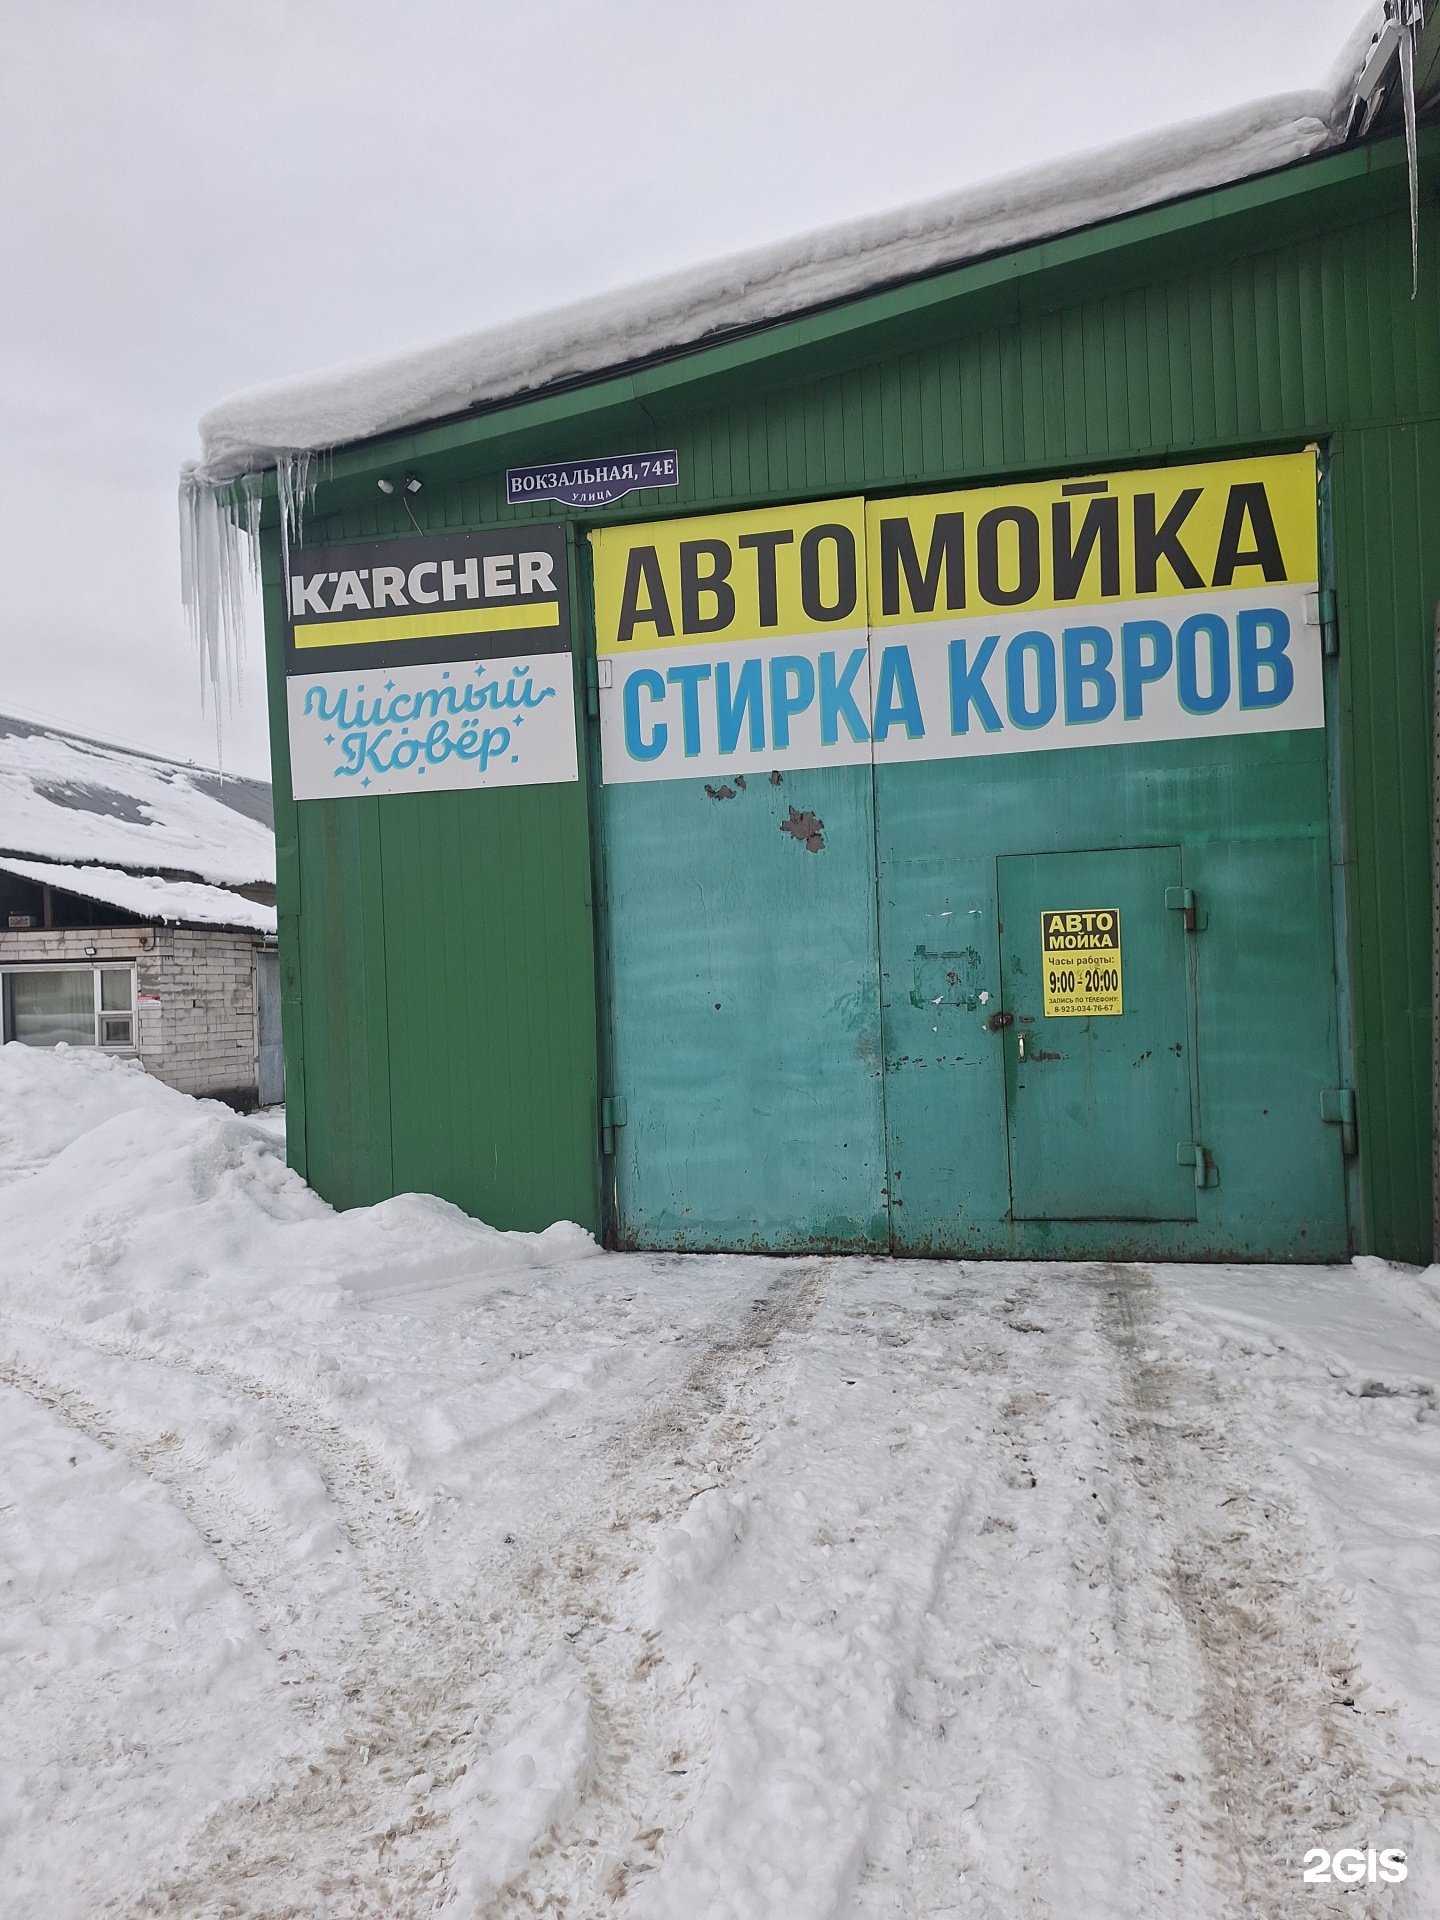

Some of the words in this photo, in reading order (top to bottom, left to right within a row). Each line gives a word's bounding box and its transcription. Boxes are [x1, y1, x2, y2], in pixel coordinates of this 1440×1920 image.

[511, 463, 638, 493] ВОКЗАЛЬНАЯ,
[641, 459, 674, 478] 74Е
[572, 489, 612, 502] УЛИЦА
[291, 551, 558, 616] KÄRCHER
[303, 665, 556, 731] Чистый
[622, 644, 927, 762] СТИРКА
[948, 607, 1294, 735] КОВРОВ
[1048, 912, 1114, 934] АВТО
[1049, 931, 1113, 950] МОЙКА
[1048, 957, 1074, 966] Часы
[1076, 956, 1115, 967] работы:
